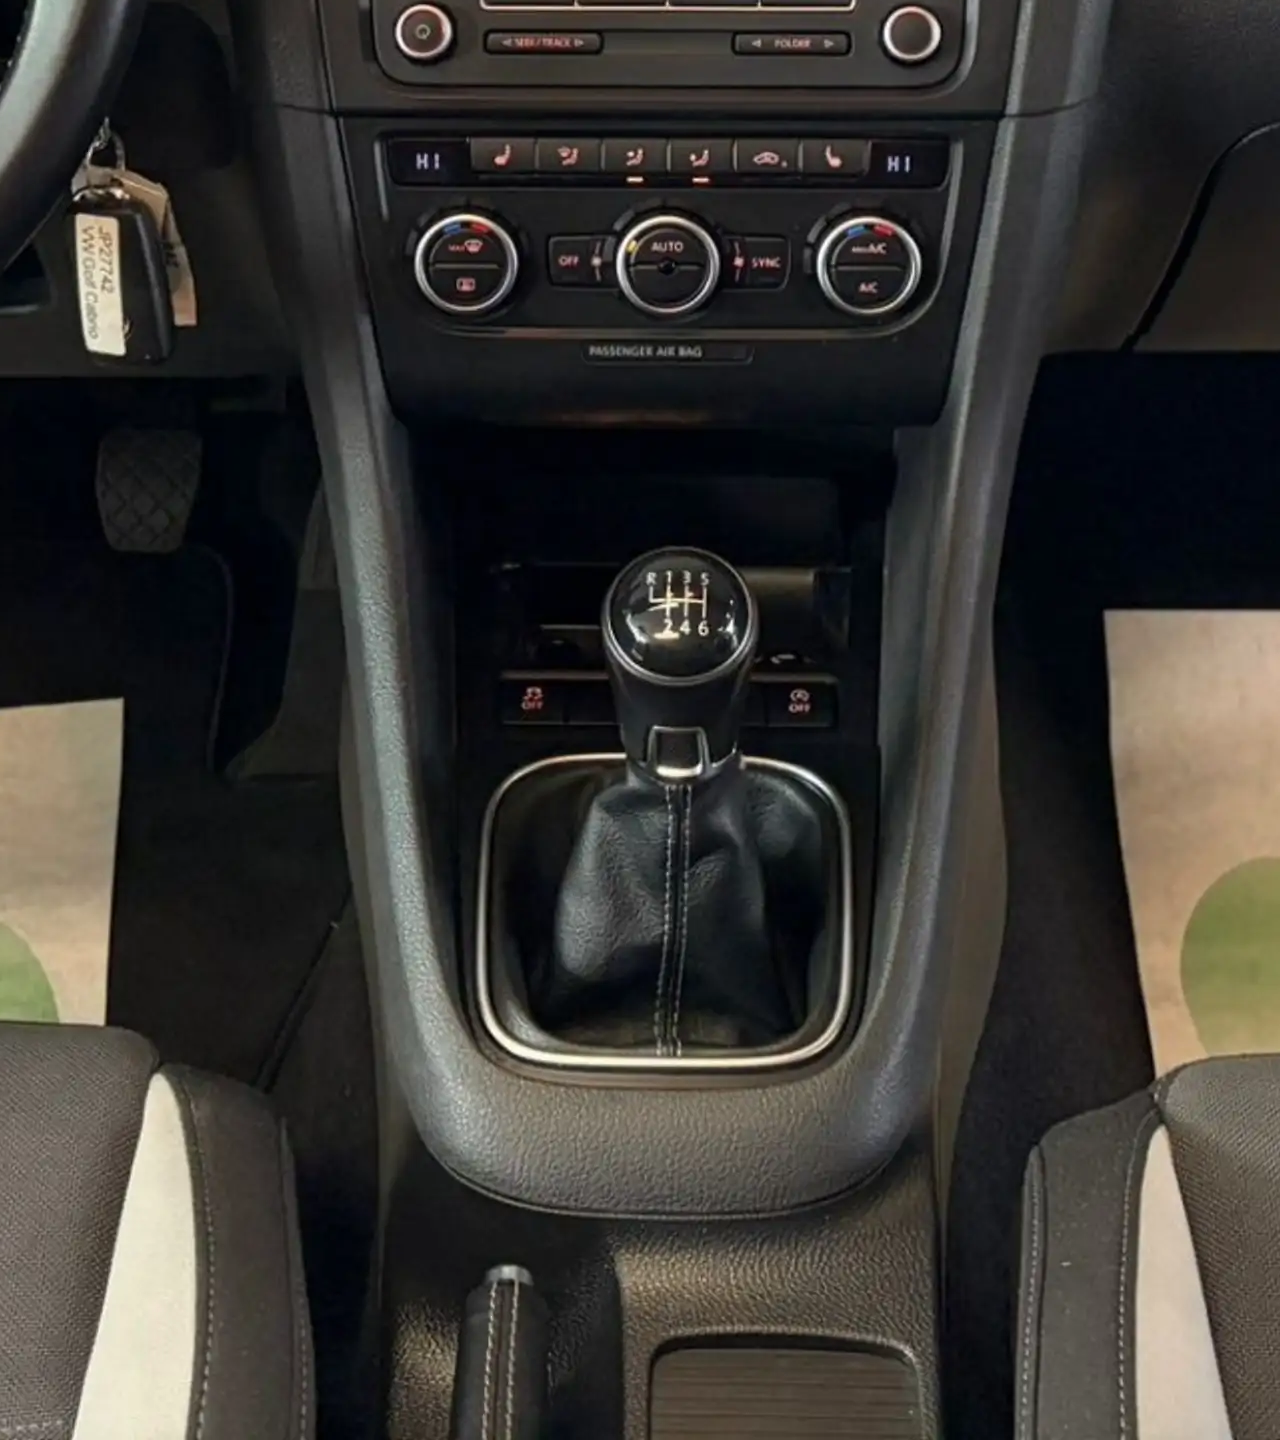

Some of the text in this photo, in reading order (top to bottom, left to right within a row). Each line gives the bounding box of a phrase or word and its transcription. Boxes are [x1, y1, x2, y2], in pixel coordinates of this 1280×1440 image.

[651, 242, 684, 252] AUTO
[558, 255, 579, 267] OFF
[751, 257, 782, 268] SYNC
[588, 345, 703, 357] PASSENGER AIR BAG
[646, 570, 711, 586] R 1 3 5
[663, 618, 710, 636] 2 4 6
[788, 703, 811, 713] OFF
